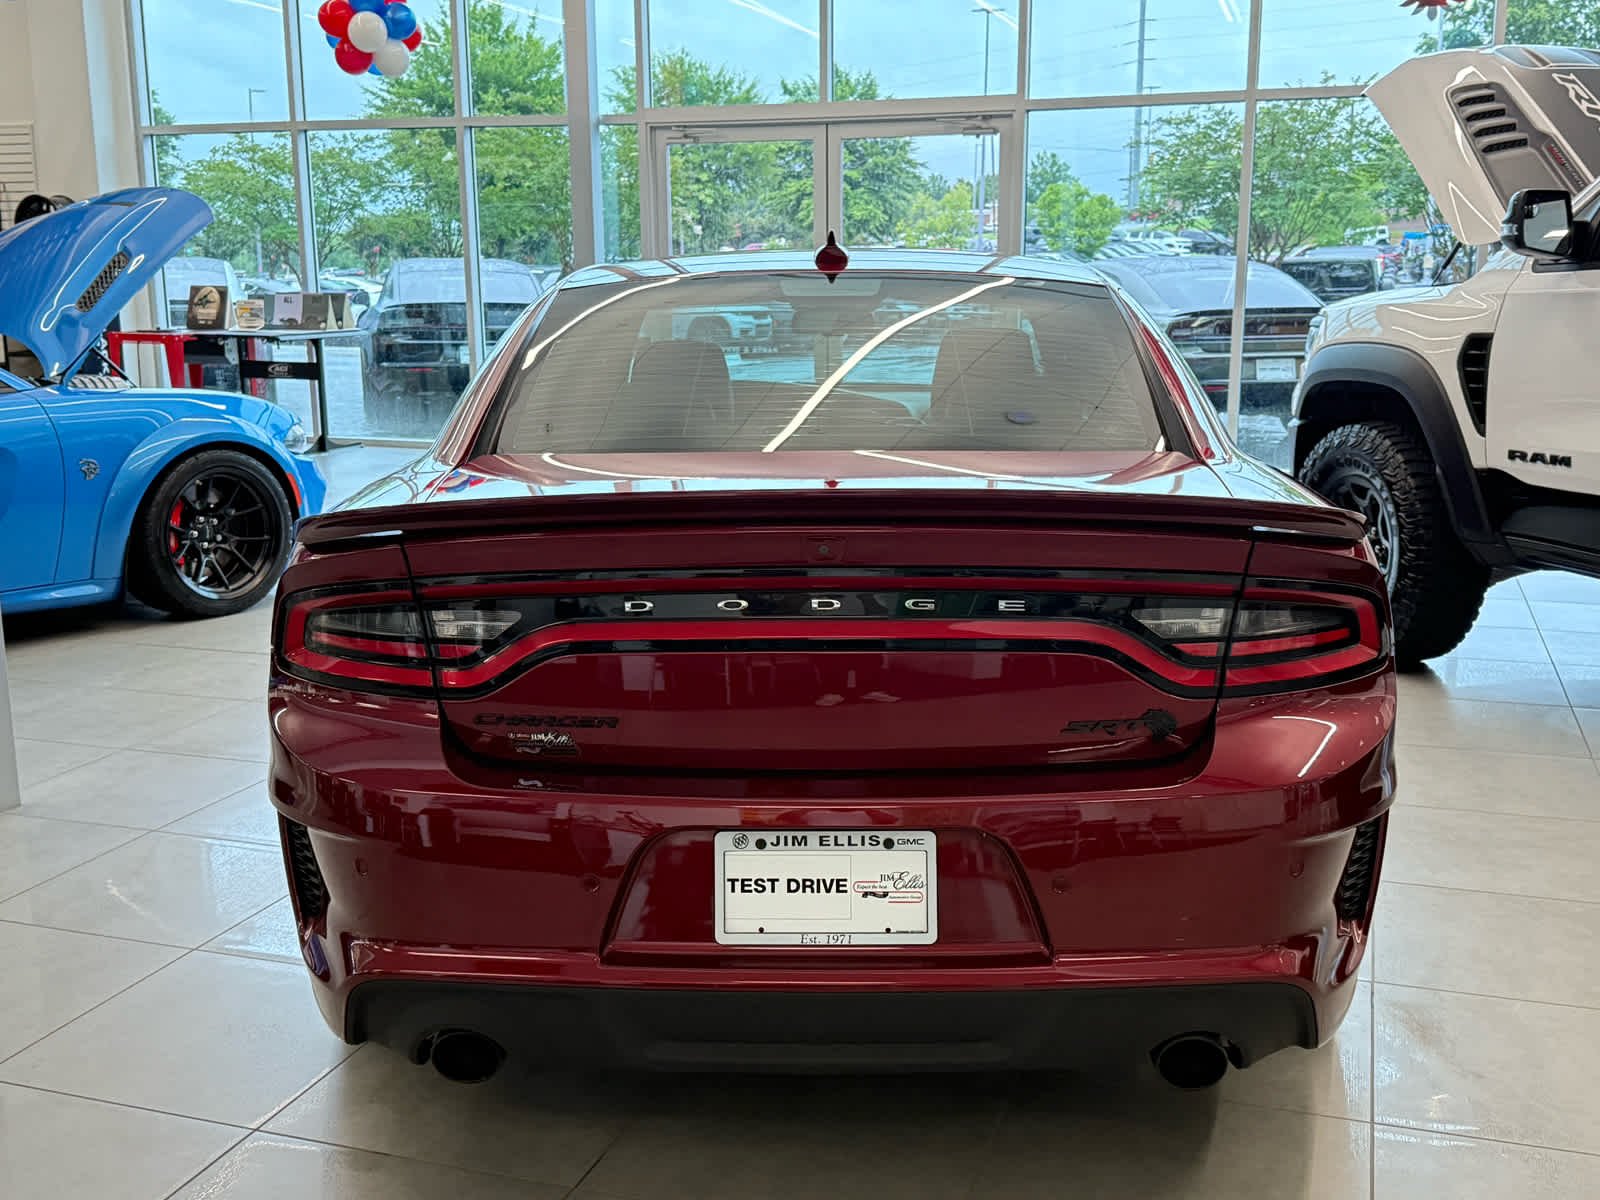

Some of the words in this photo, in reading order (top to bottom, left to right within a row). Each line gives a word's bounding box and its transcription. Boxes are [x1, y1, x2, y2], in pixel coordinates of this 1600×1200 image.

[1507, 449, 1572, 468] RAM
[624, 599, 1026, 612] DODGE
[474, 713, 620, 729] CHARGER
[770, 835, 808, 847] JIM
[818, 835, 881, 847] ELLIS
[896, 838, 925, 846] GMC
[727, 878, 780, 894] TEST
[786, 878, 848, 894] DRIVE
[880, 873, 895, 882] JIM
[893, 870, 924, 890] Ellis
[800, 934, 822, 945] Est.
[826, 934, 853, 945] 1971
